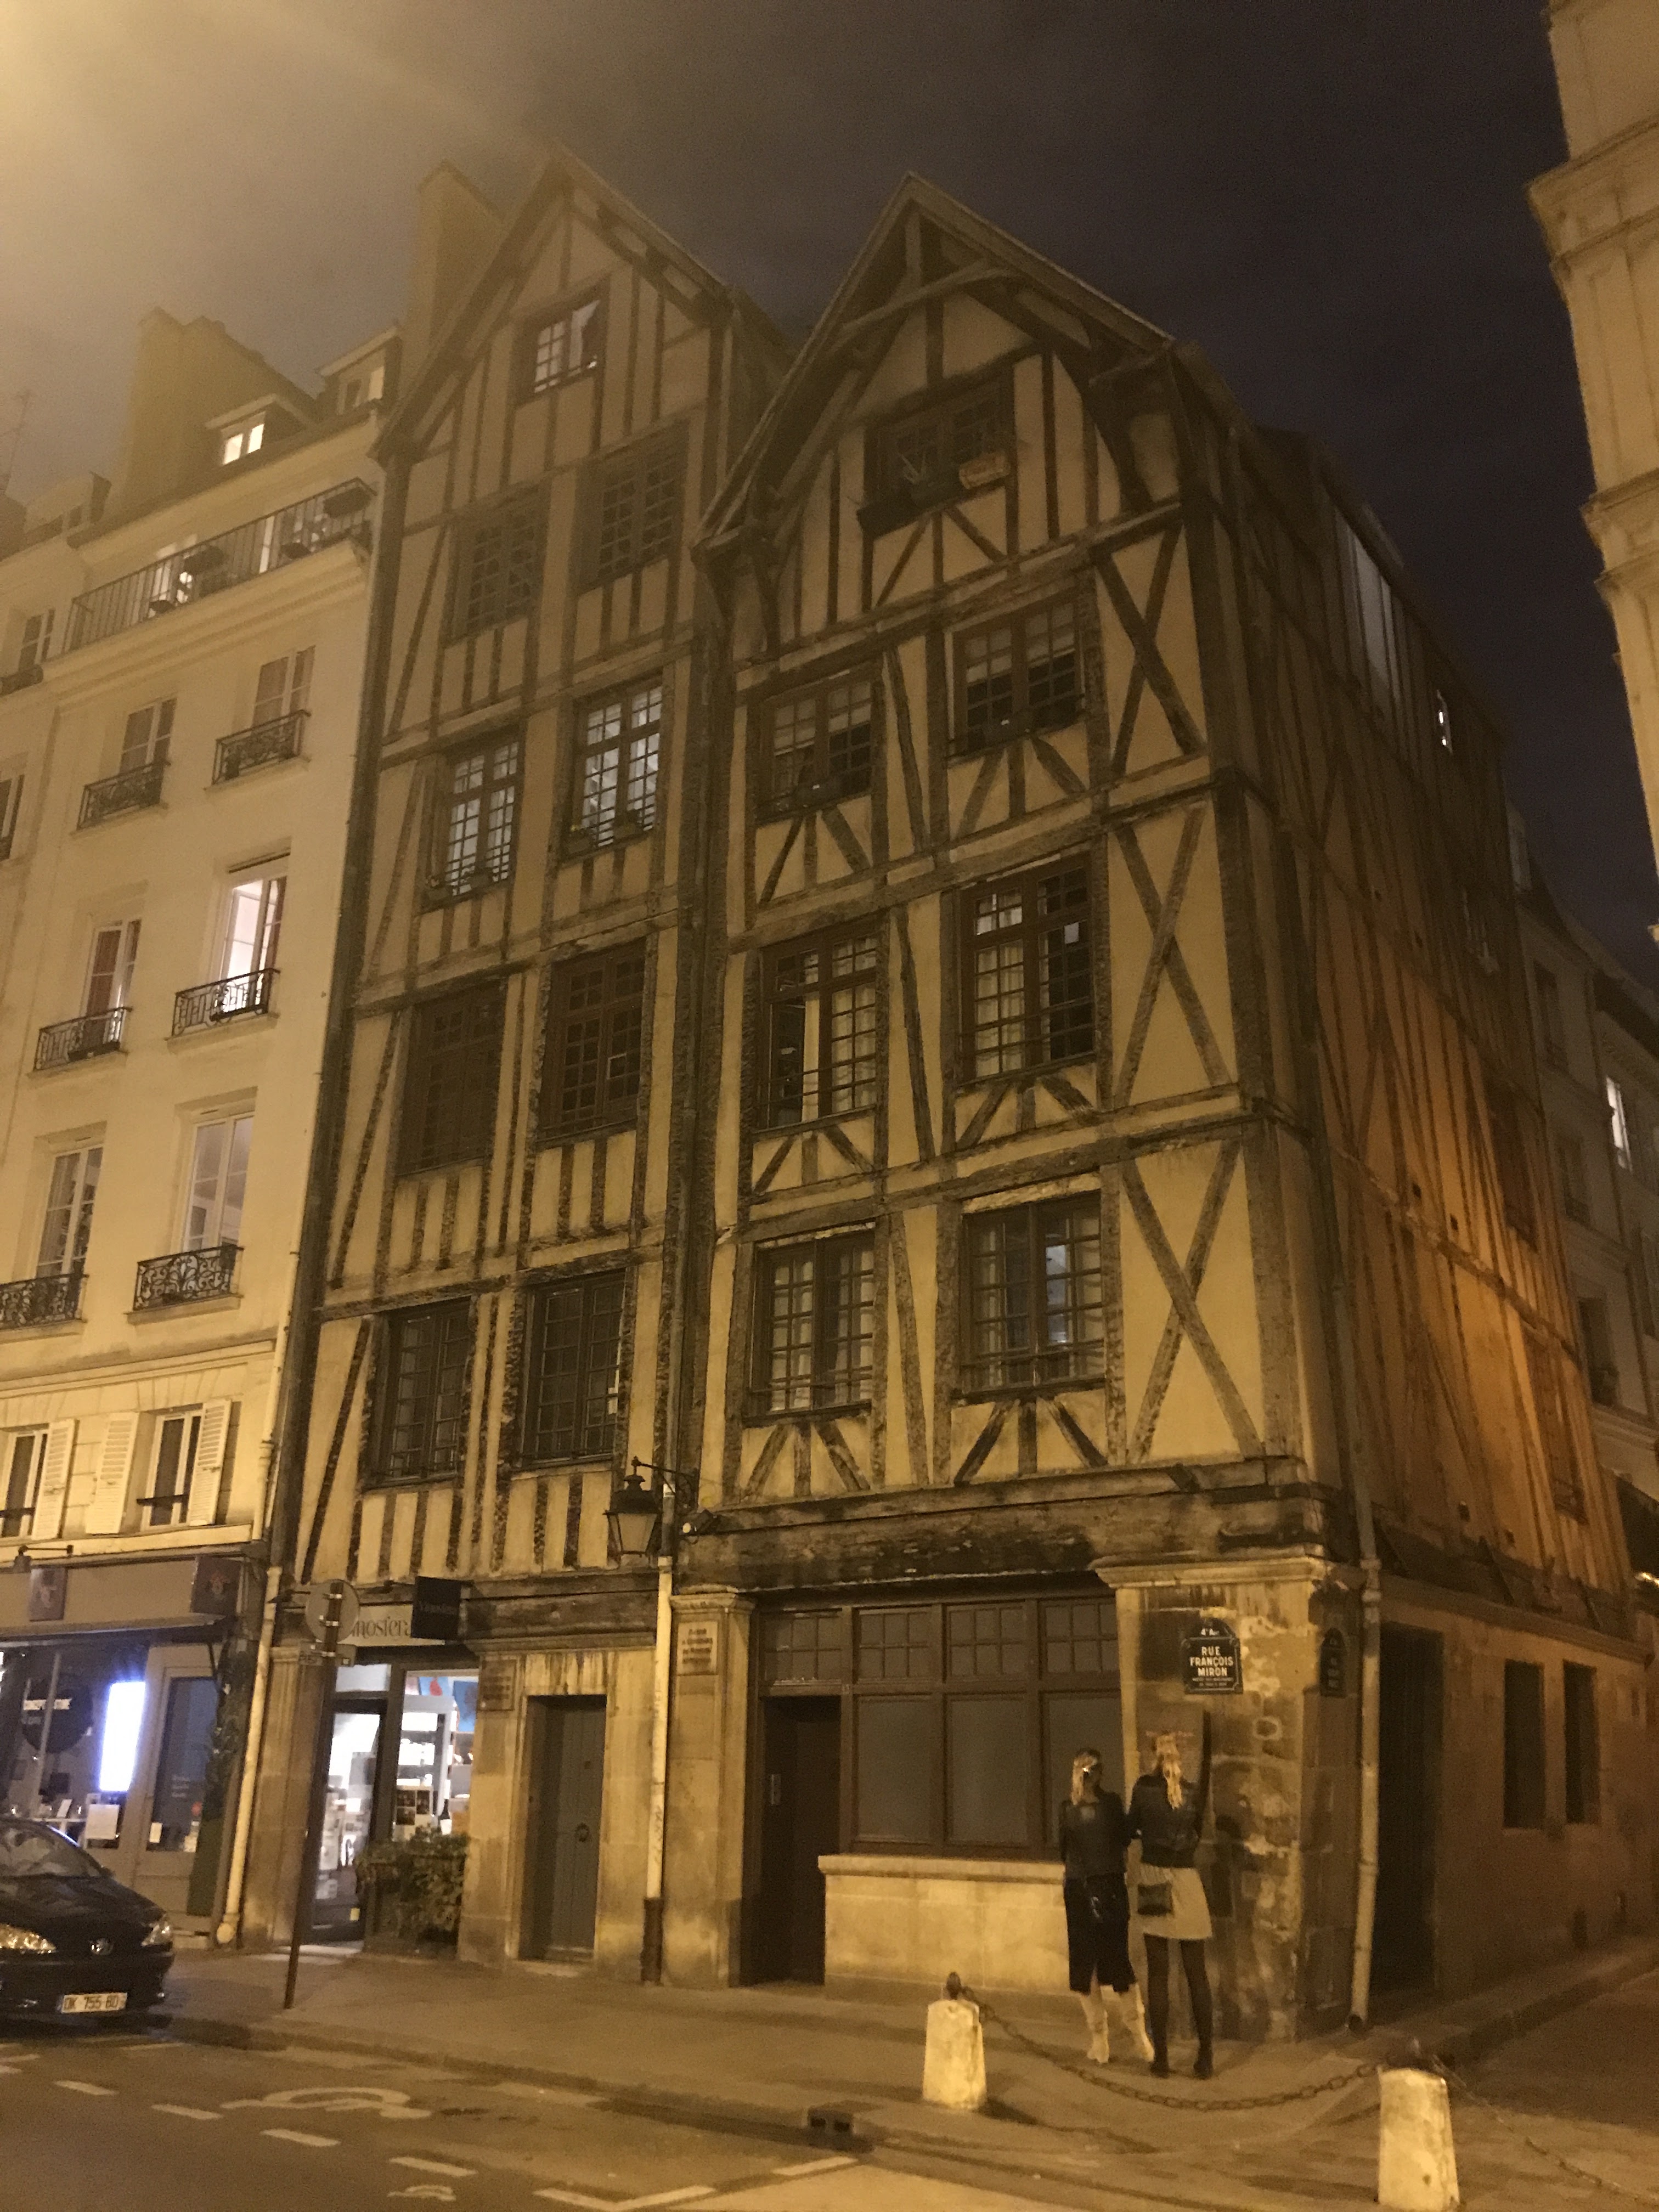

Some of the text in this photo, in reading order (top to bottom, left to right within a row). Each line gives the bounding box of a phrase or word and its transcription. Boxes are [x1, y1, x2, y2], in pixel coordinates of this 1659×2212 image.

[1201, 1646, 1221, 1656] RUE
[1190, 1656, 1234, 1667] FRANÇOIS
[1198, 1667, 1227, 1677] MIRON
